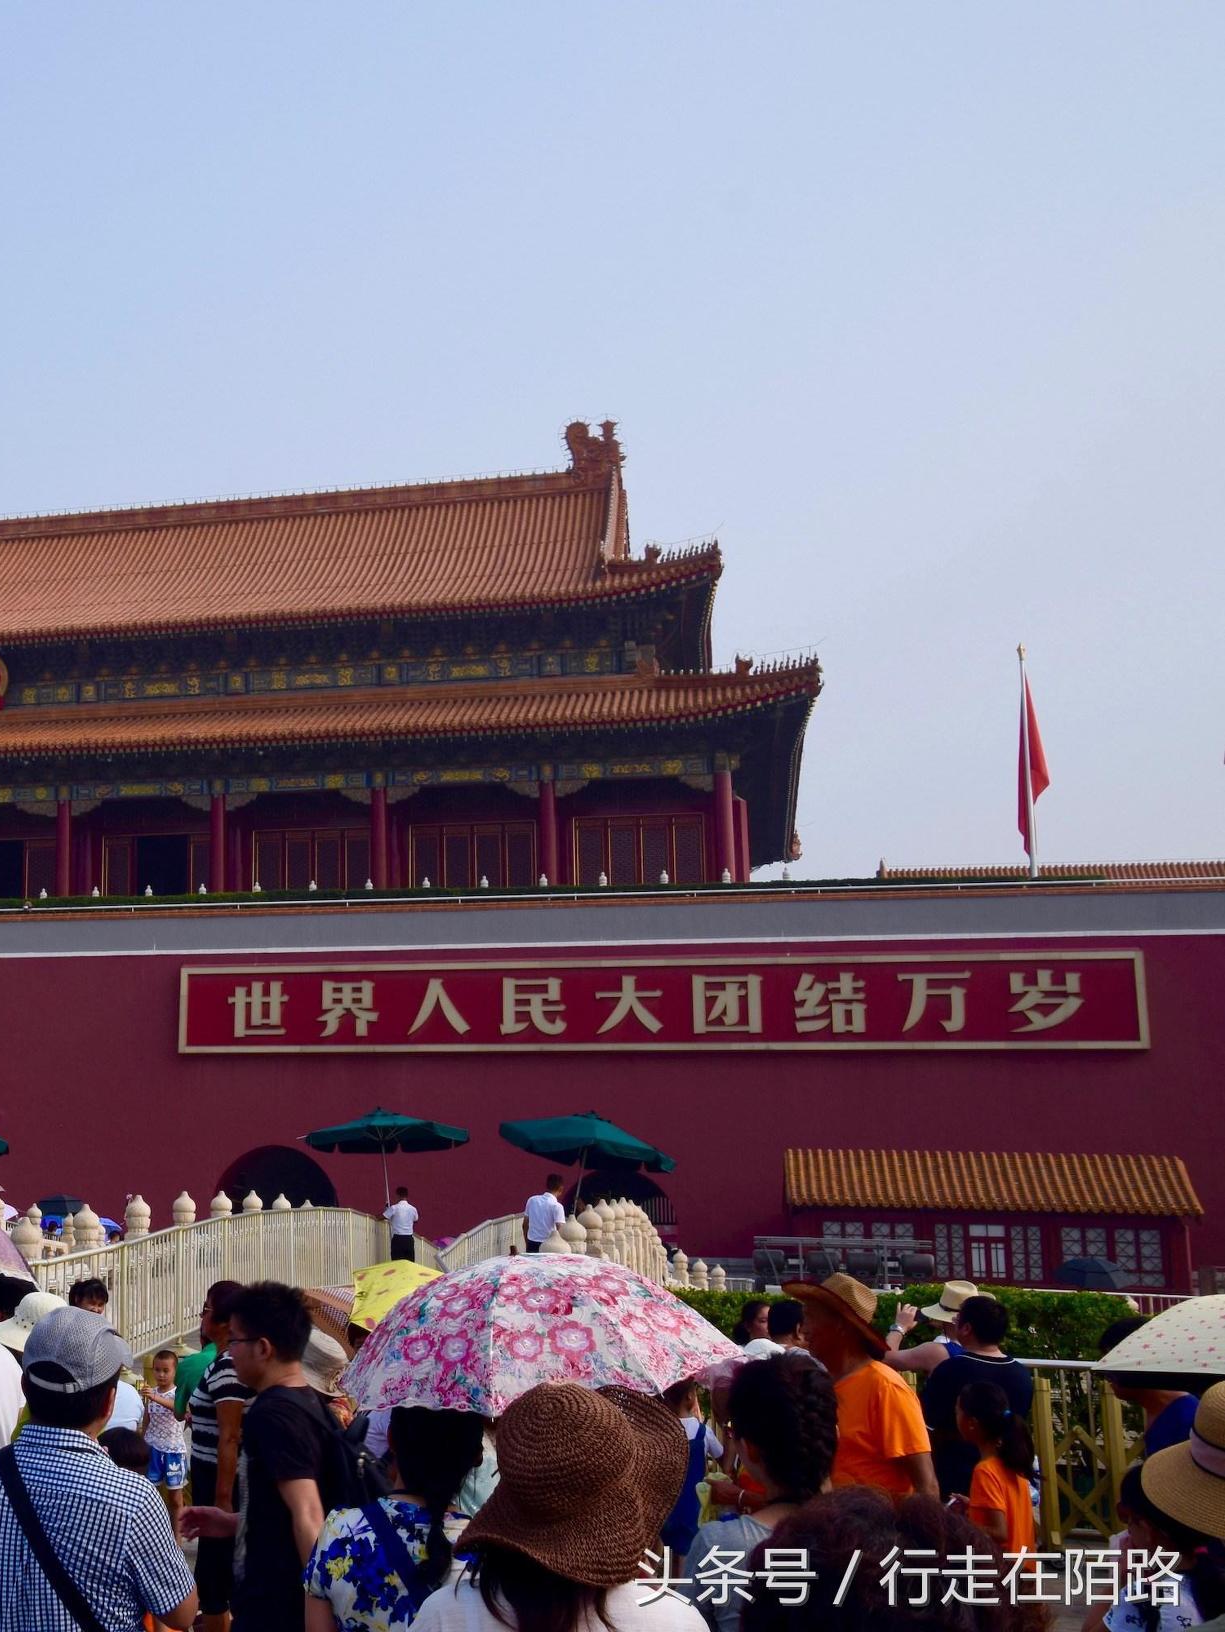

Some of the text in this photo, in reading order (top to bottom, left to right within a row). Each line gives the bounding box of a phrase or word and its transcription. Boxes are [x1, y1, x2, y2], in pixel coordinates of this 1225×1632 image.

[227, 968, 1085, 1038] 世界人民大团结万岁
